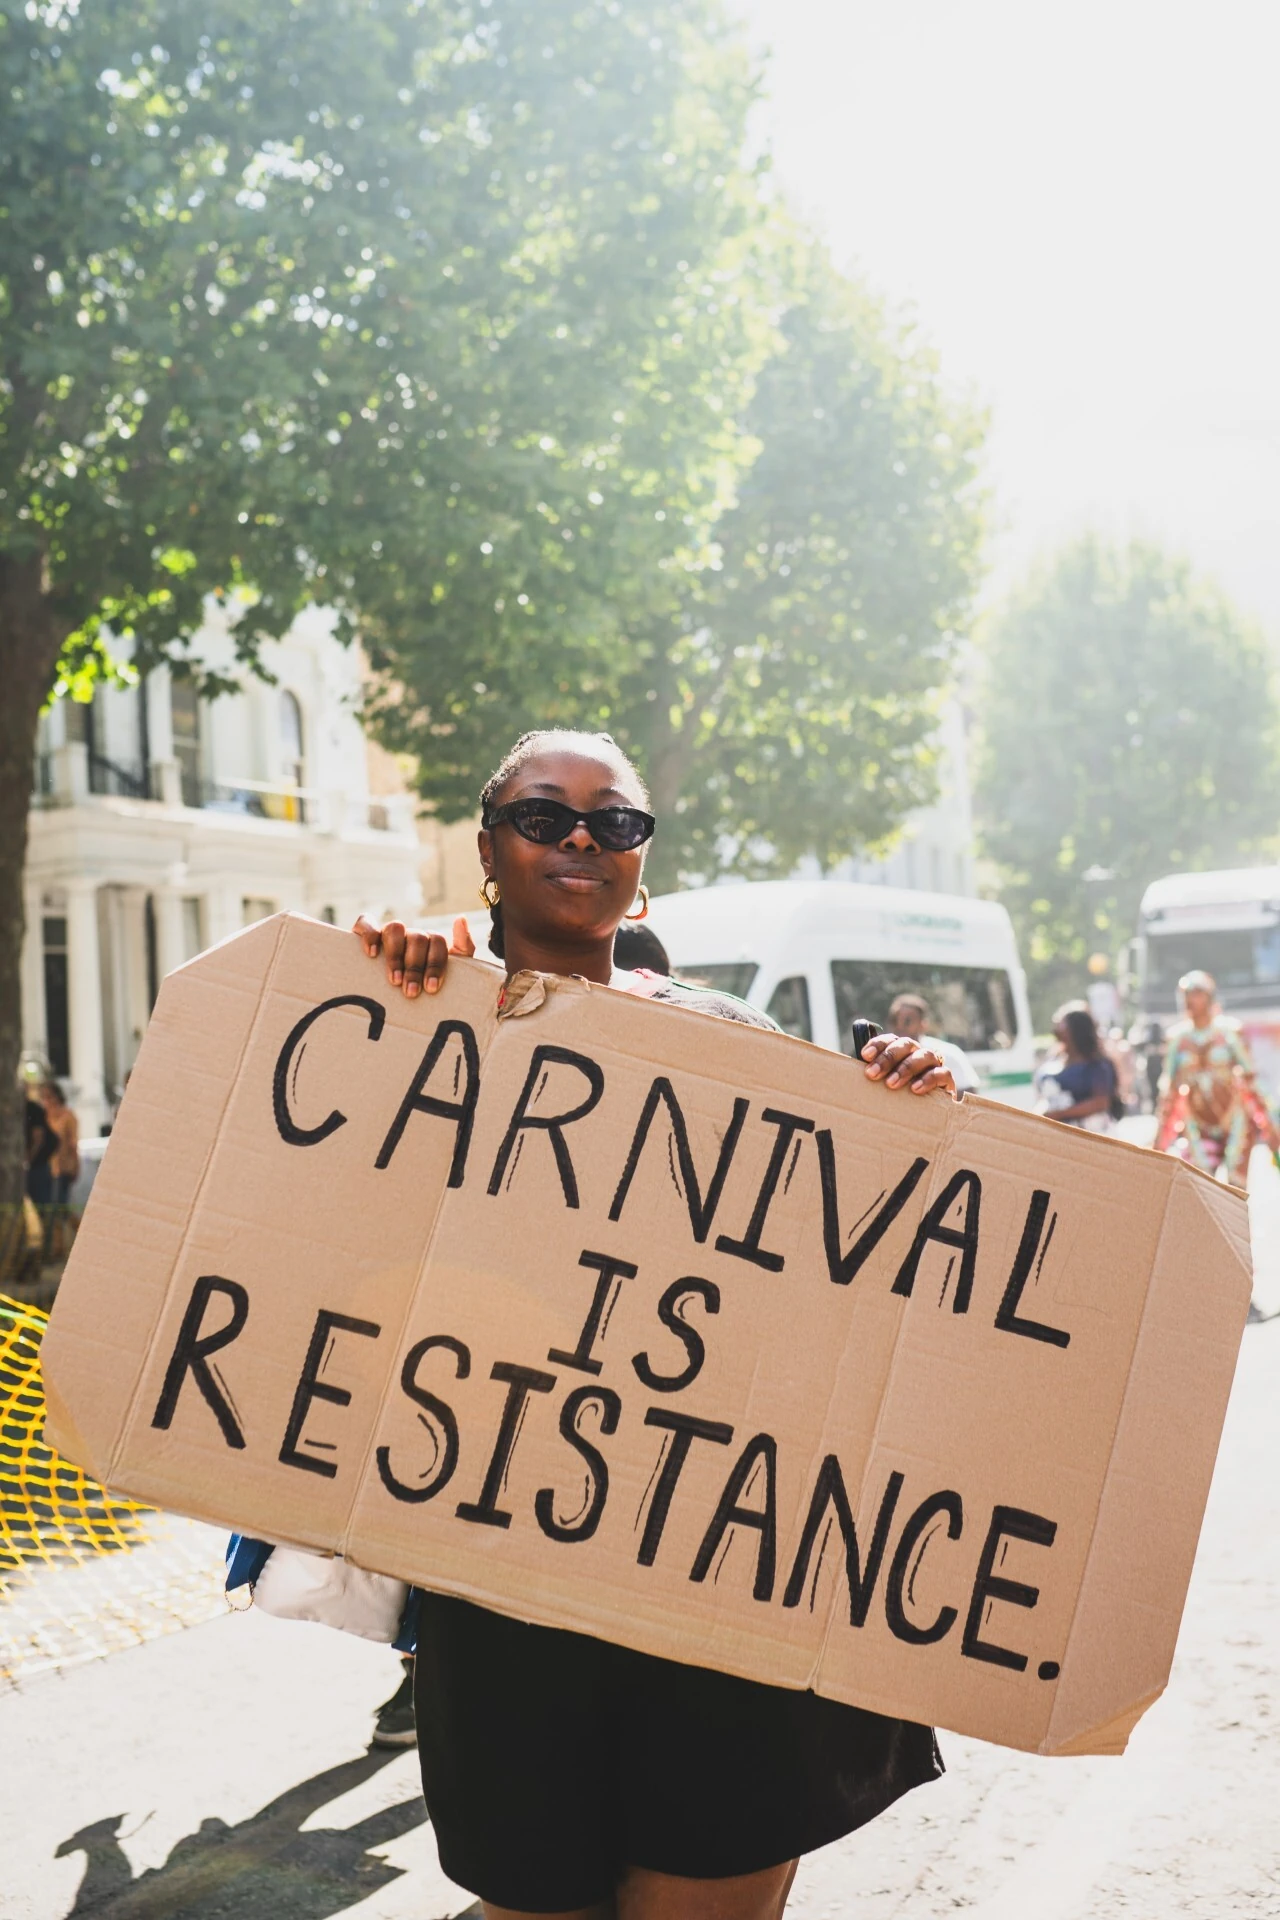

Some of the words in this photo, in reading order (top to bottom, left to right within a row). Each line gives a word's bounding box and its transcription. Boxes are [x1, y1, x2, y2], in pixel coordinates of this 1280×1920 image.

[273, 995, 1070, 1348] CARNIVAL
[548, 1250, 720, 1392] IS
[151, 1276, 1060, 1680] RESISTANCE.
